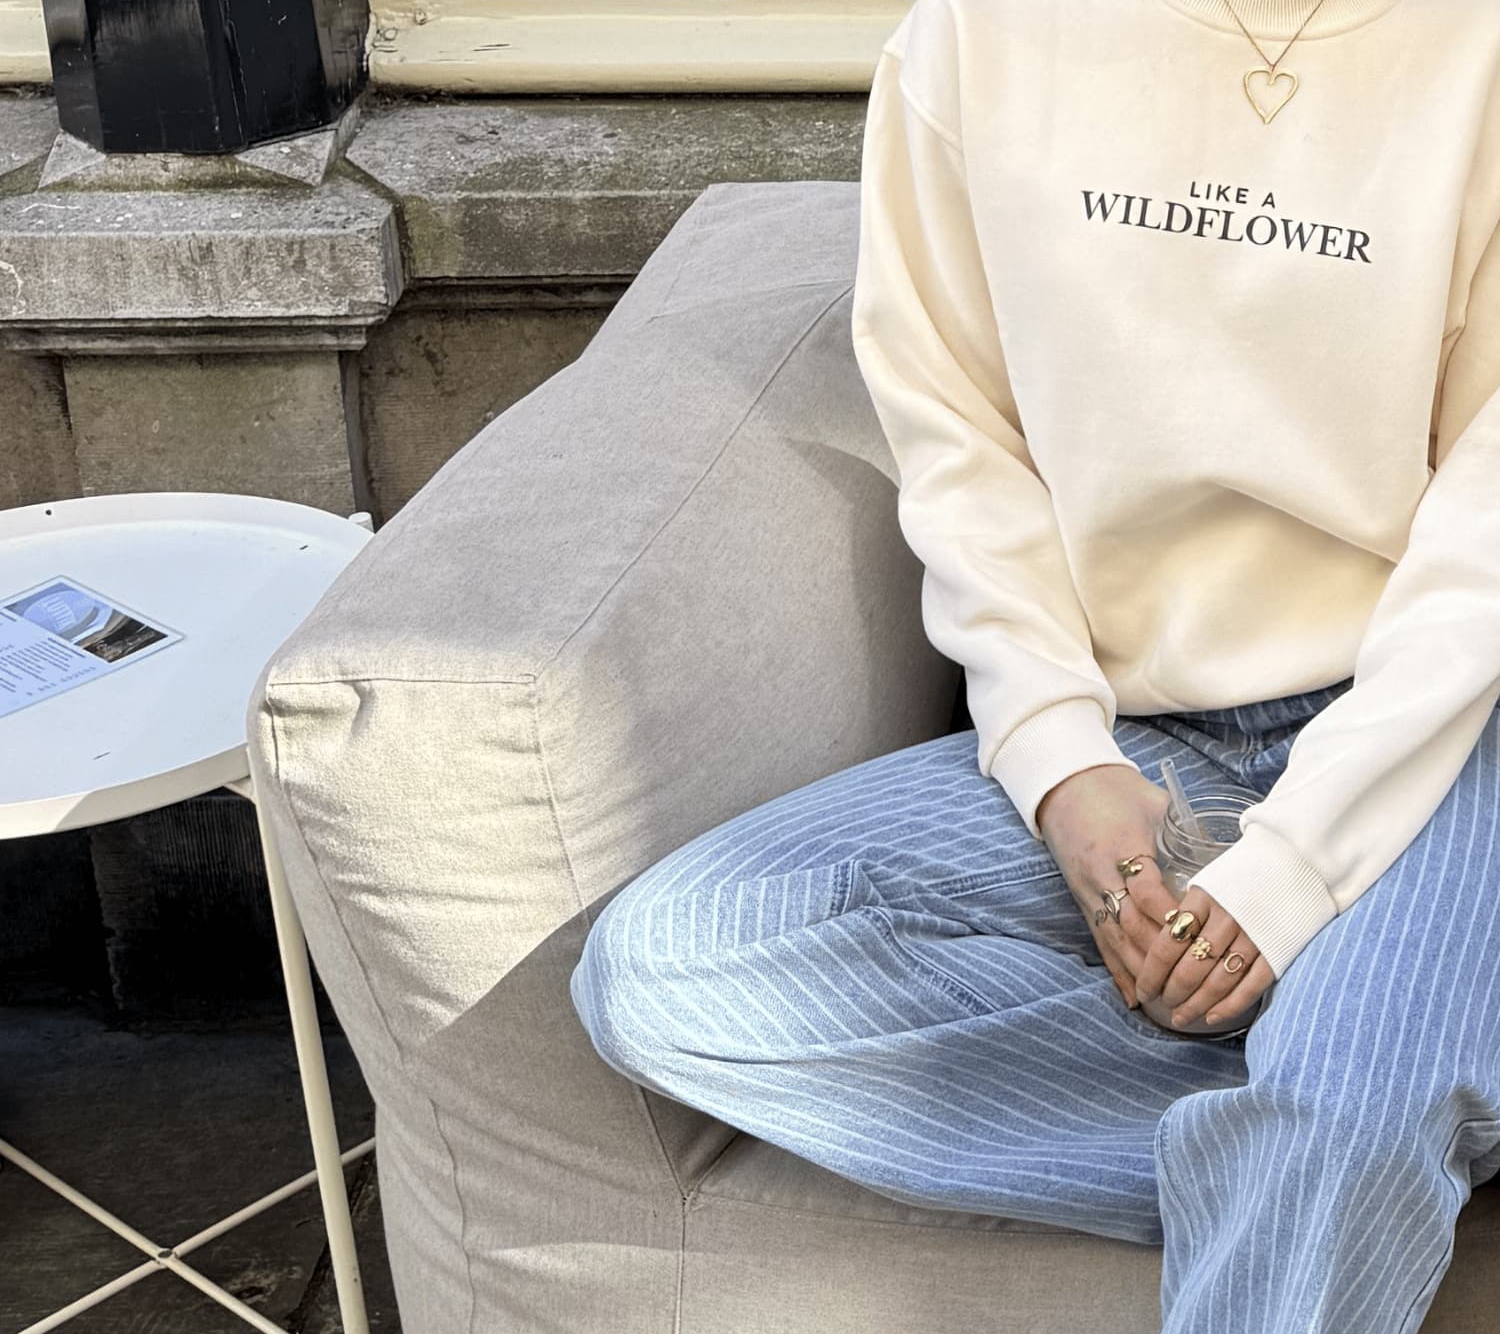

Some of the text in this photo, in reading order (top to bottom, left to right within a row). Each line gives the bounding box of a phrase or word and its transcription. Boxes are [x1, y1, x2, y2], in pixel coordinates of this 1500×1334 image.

[1190, 181, 1276, 209] LIKE A
[1081, 190, 1372, 264] WILDFLOWER
